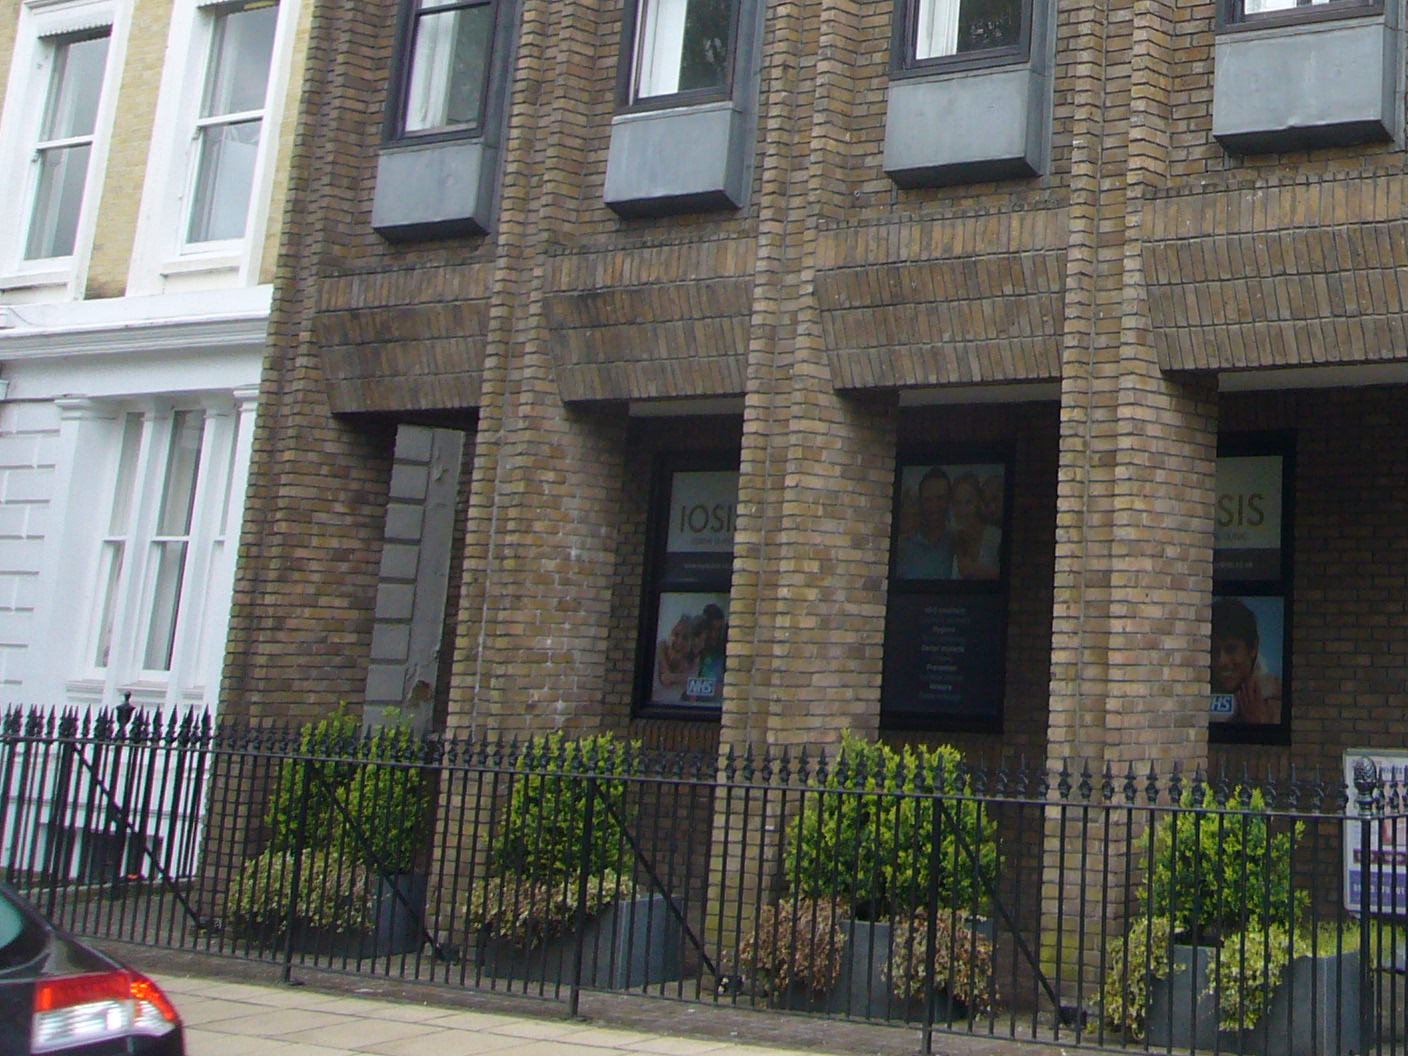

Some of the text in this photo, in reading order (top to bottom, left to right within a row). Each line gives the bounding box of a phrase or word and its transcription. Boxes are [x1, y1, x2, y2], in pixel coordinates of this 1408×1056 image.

[680, 504, 733, 534] IOSI
[1217, 493, 1265, 527] SIS
[1209, 695, 1232, 712] HS
